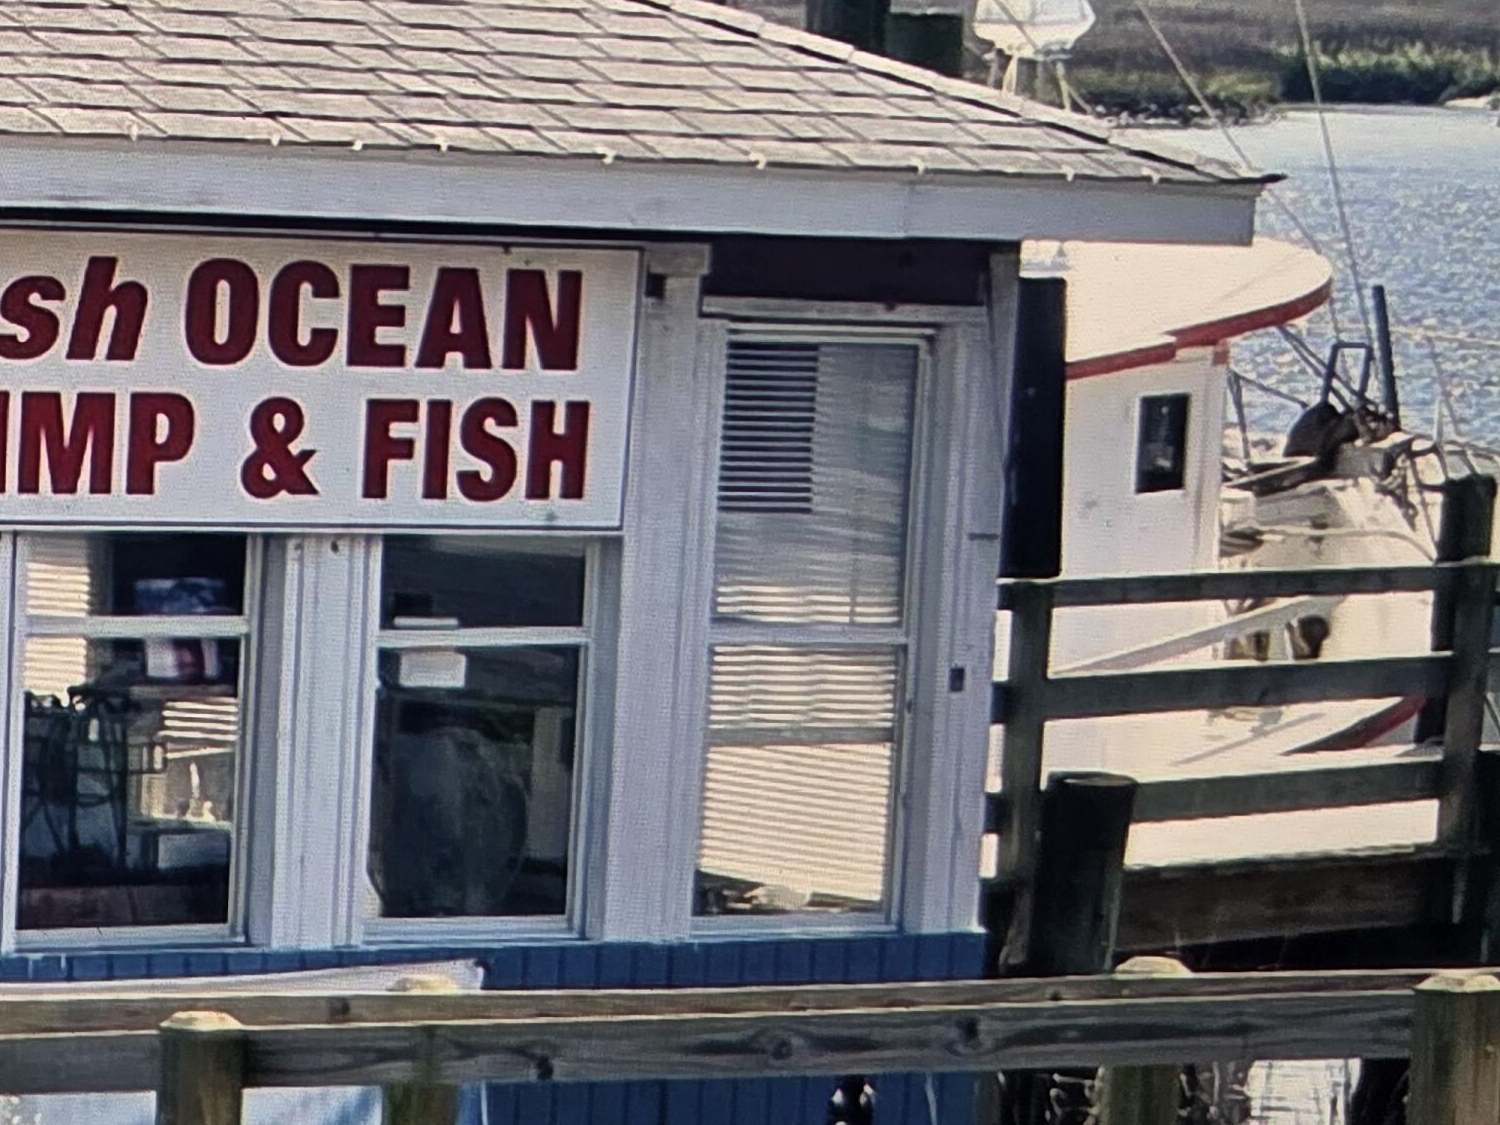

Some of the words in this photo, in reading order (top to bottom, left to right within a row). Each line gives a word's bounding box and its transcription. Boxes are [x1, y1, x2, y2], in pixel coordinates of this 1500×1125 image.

[184, 256, 584, 371] OCEAN
[241, 395, 320, 500] &
[362, 397, 592, 503] FISH
